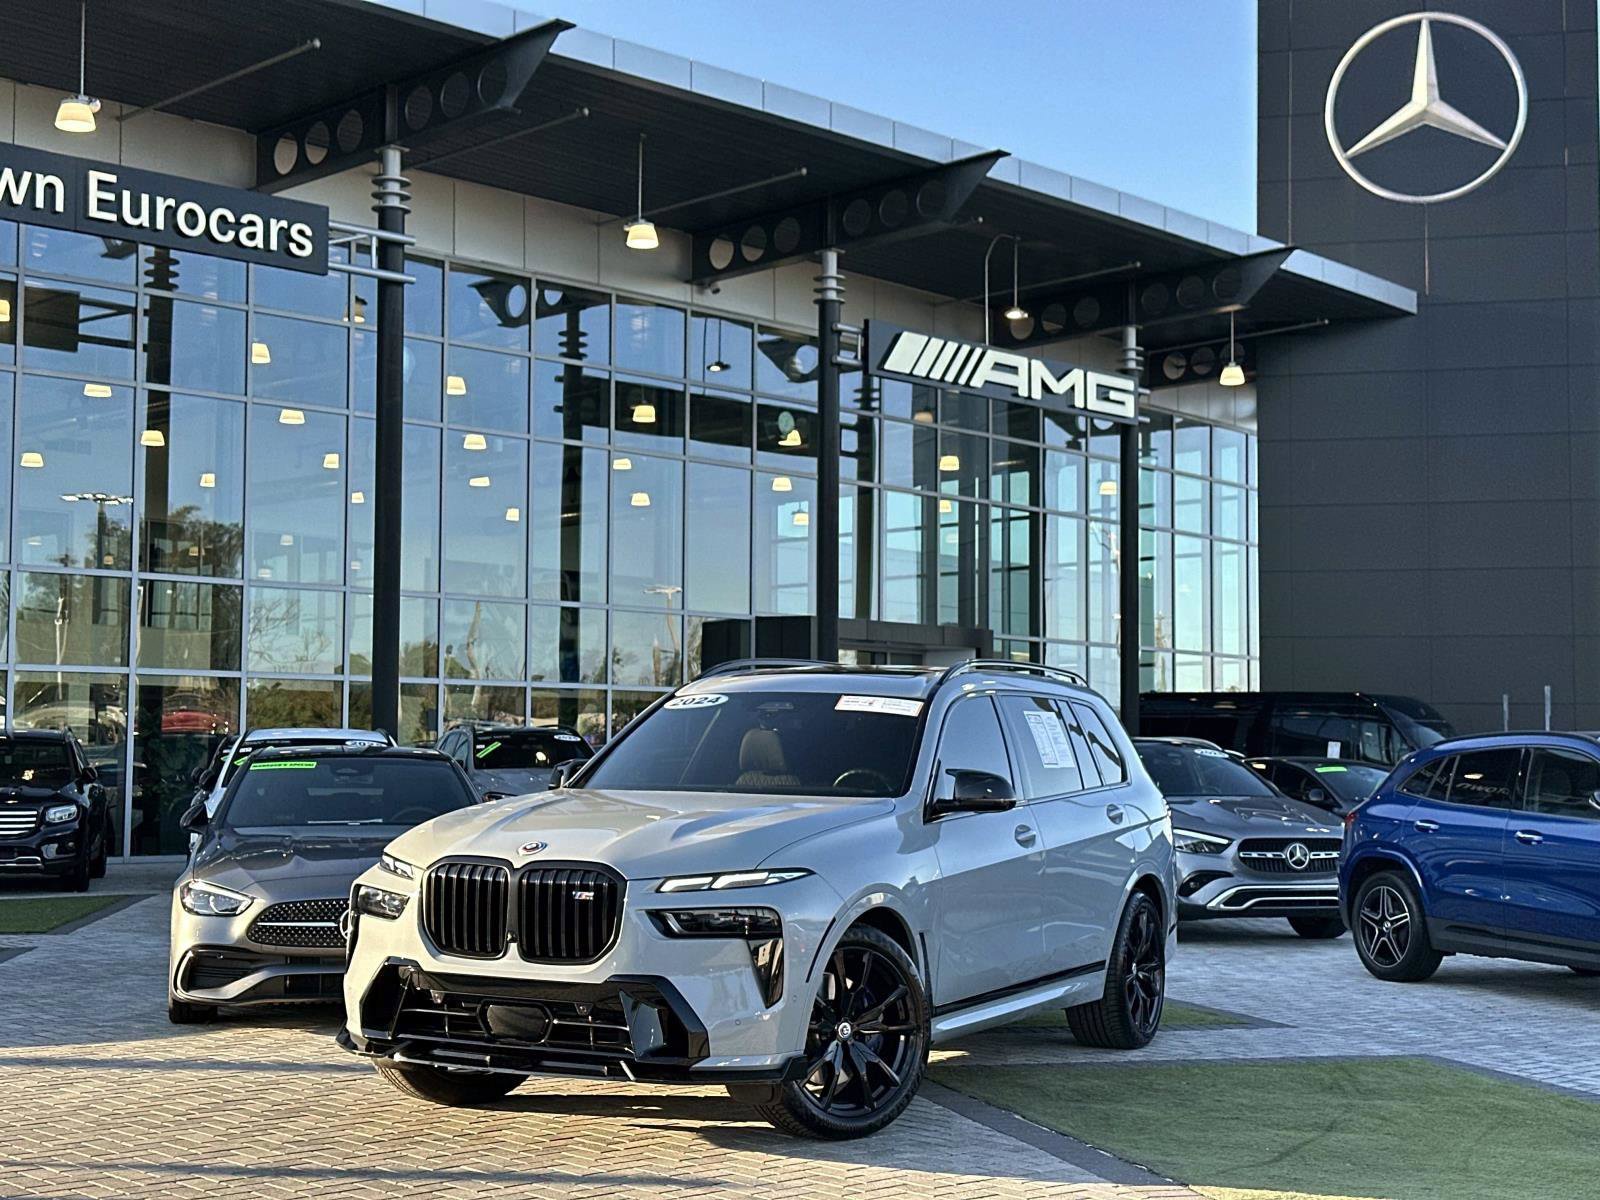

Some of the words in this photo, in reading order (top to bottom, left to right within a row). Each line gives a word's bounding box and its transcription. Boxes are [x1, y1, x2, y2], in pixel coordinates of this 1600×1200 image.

[0, 167, 65, 213] wn
[87, 169, 314, 258] Eurocars
[969, 349, 1135, 419] AMG
[669, 696, 722, 707] 2024
